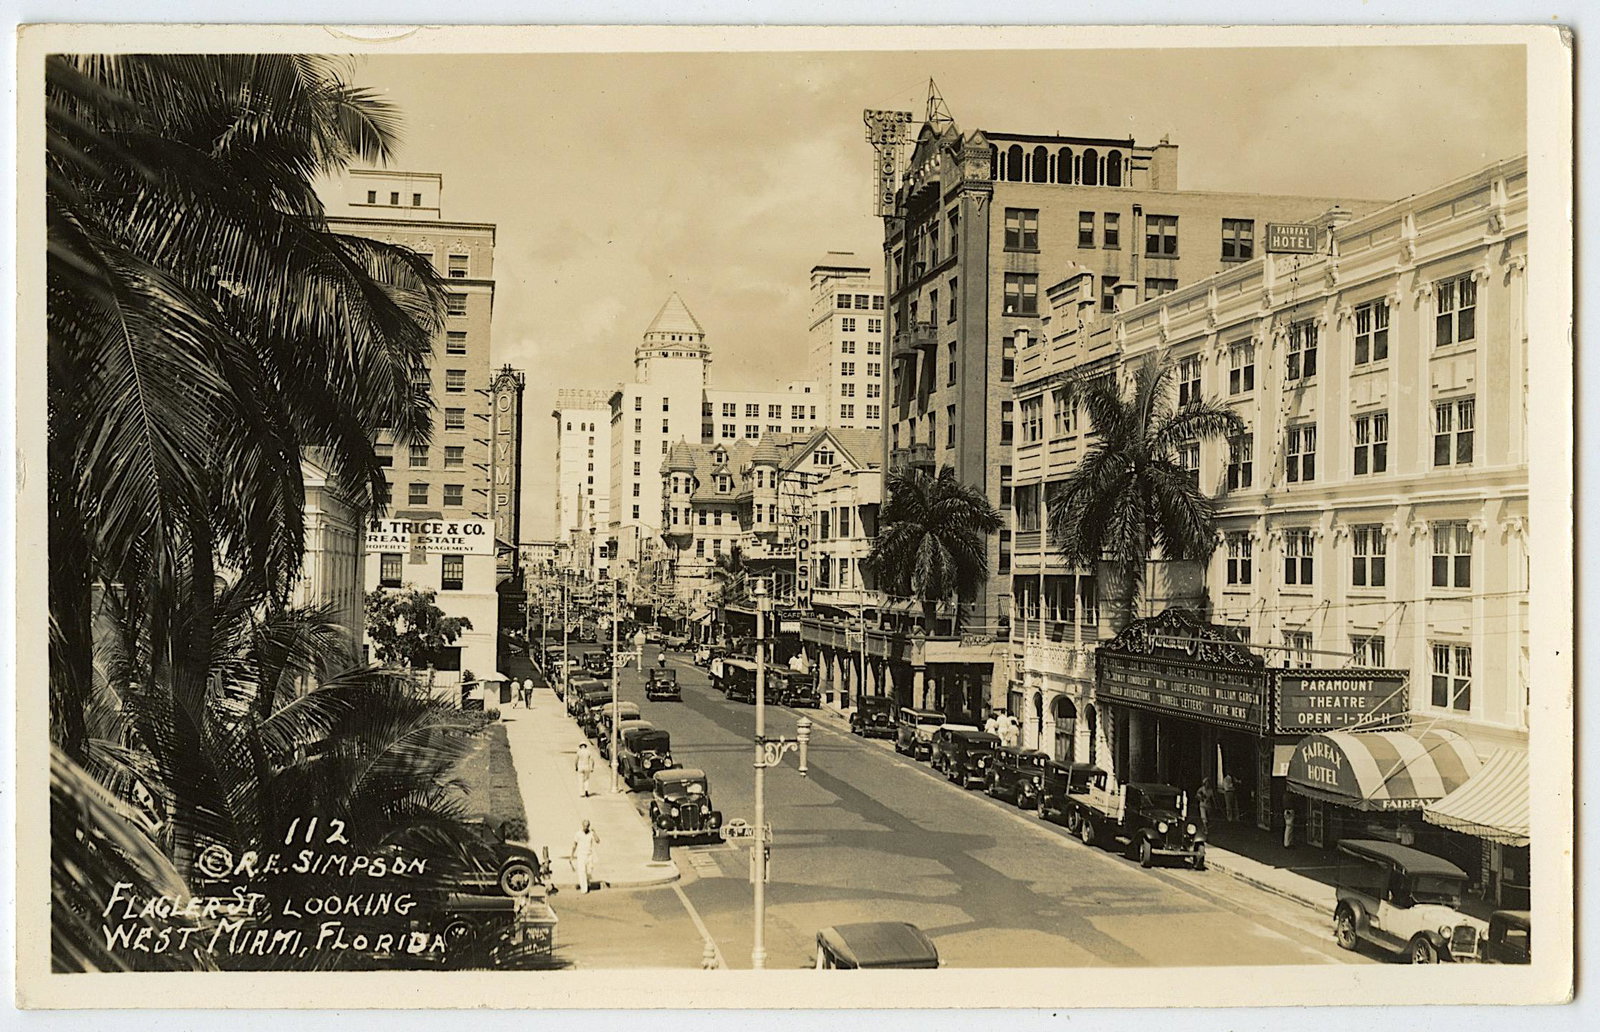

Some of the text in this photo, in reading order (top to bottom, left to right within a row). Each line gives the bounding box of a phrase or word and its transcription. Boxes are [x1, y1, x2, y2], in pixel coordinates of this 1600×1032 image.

[1277, 226, 1309, 235] FAIRFAX
[1273, 236, 1312, 249] HOTEL
[495, 394, 511, 537] OLYMPI
[389, 522, 443, 535] TRICE
[447, 523, 459, 535] &
[463, 523, 486, 536] CO.
[368, 535, 466, 544] REAL ESTATE
[797, 524, 809, 609] HOLSUM
[1301, 680, 1374, 692] PARAMOUNT
[1309, 697, 1366, 708] THEATRE
[1298, 712, 1331, 724] OPEN
[1302, 742, 1342, 770] FAIRFAX
[1307, 765, 1338, 786] HOTEL
[1382, 799, 1434, 809] FAIRFAX
